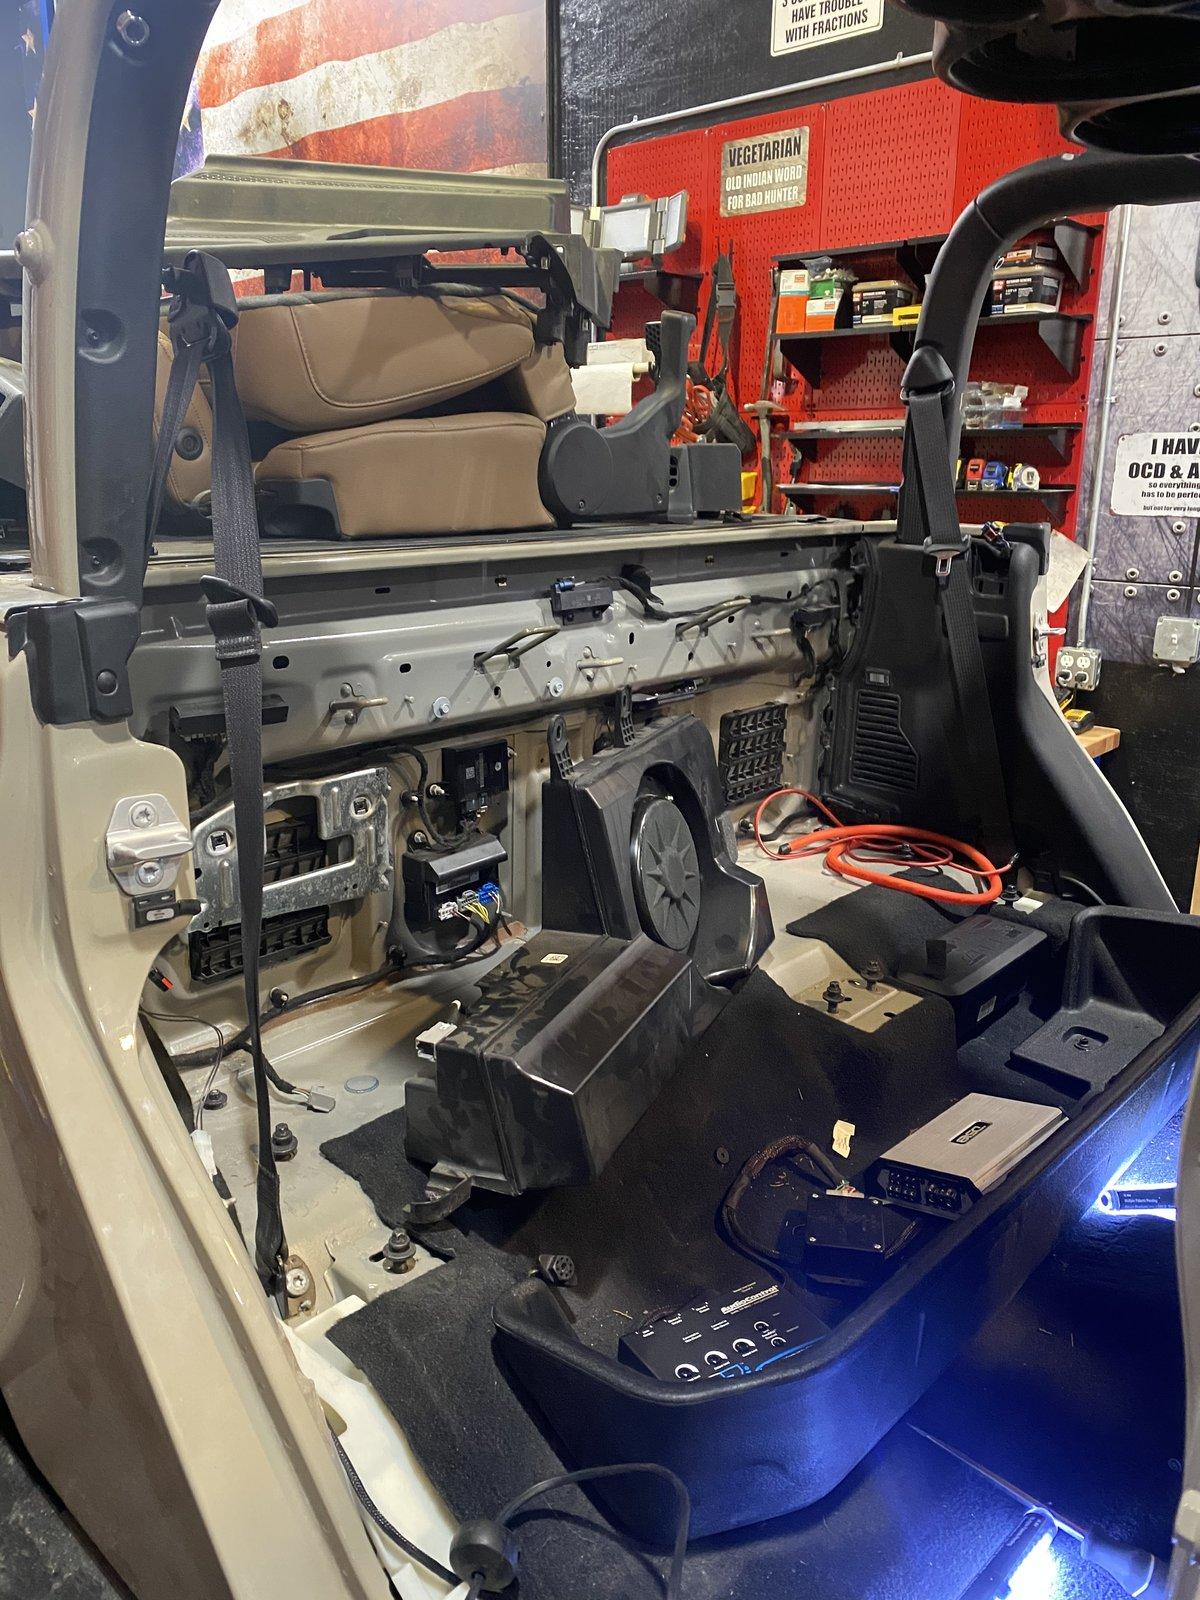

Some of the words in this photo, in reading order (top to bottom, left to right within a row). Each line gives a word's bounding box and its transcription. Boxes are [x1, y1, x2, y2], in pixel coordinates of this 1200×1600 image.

[791, 4, 816, 23] HAVE
[785, 25, 809, 43] WITH
[812, 9, 868, 36] FRACTIONS
[729, 135, 802, 168] VEGETARIAN
[725, 176, 742, 192] OLD
[743, 169, 773, 189] INDIAN
[774, 165, 803, 183] WORD
[727, 194, 744, 211] FOR
[745, 191, 763, 208] BAD
[764, 186, 799, 205] HUNTER
[1151, 438, 1158, 455] I
[1162, 438, 1200, 455] HAV
[1128, 462, 1166, 479] OCD
[1169, 465, 1184, 479] &
[1141, 490, 1156, 498] has
[1177, 491, 1200, 499] perfe
